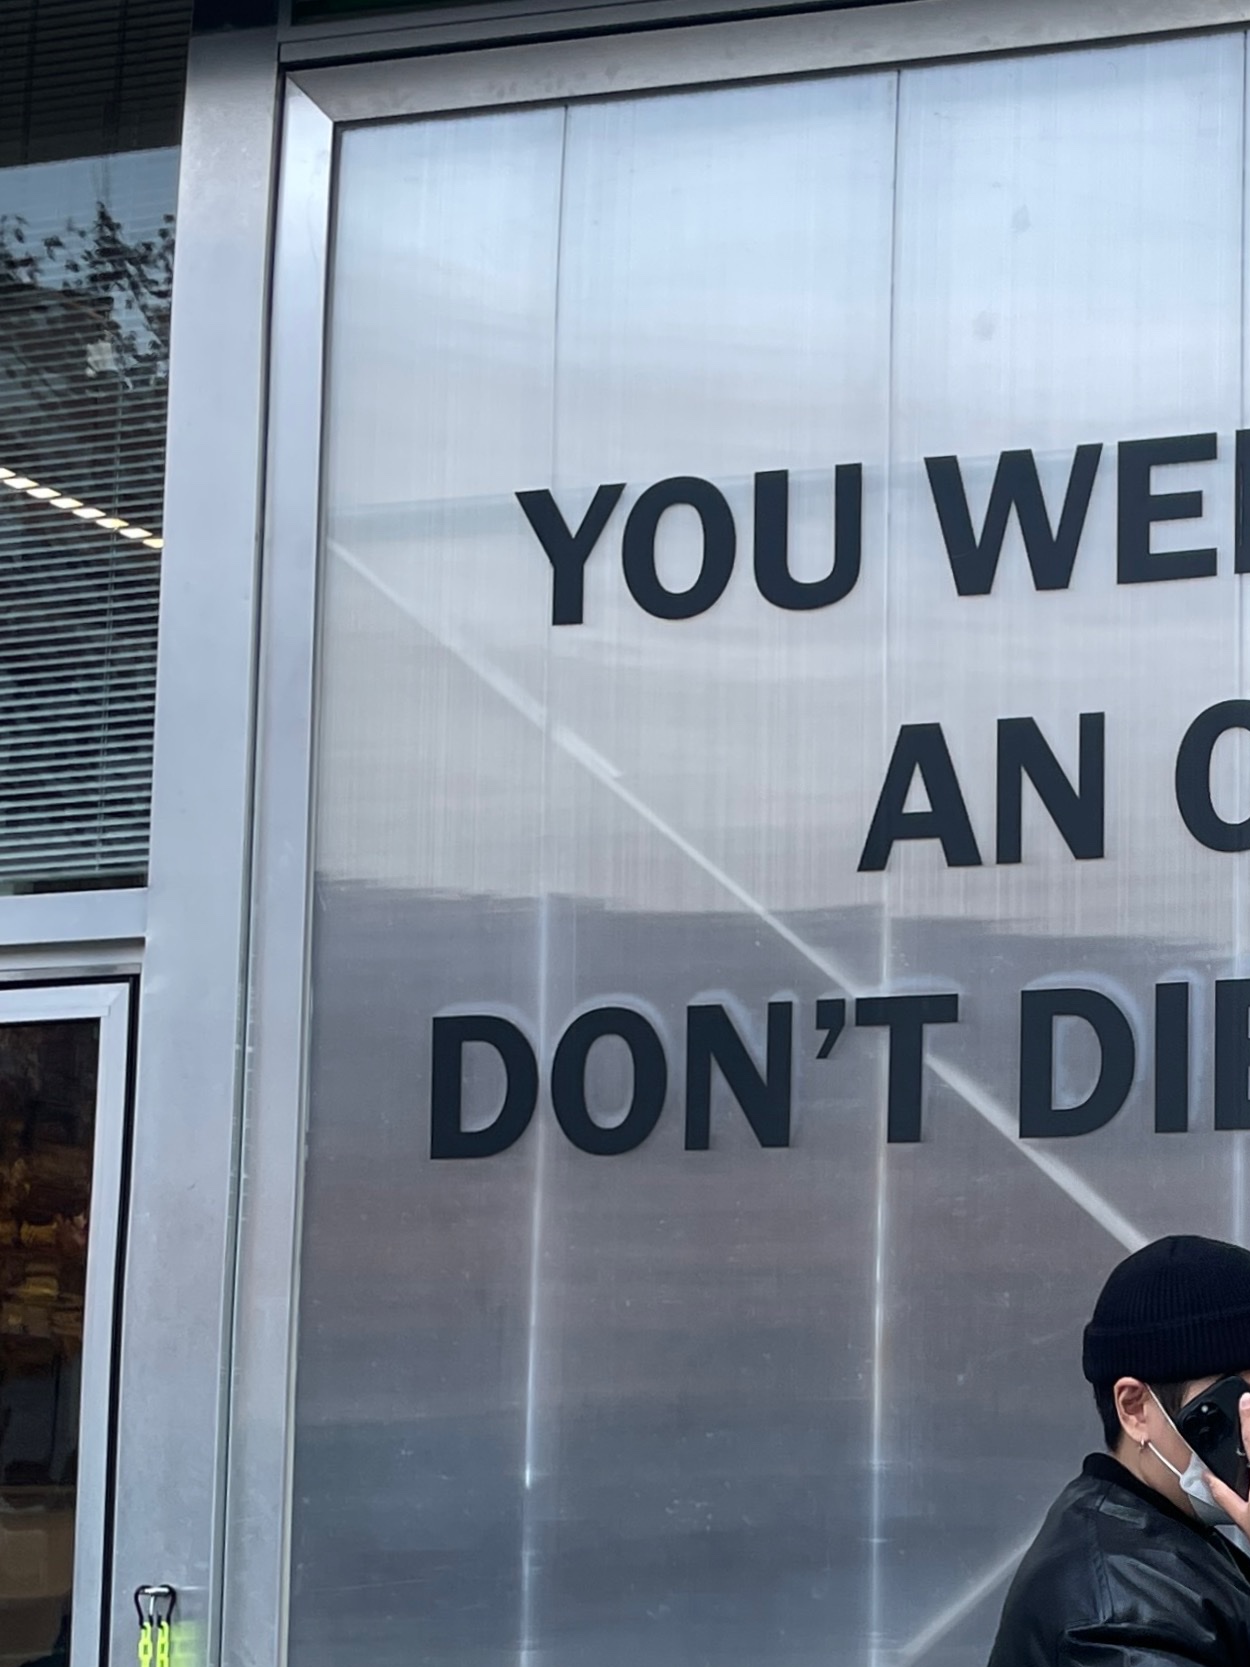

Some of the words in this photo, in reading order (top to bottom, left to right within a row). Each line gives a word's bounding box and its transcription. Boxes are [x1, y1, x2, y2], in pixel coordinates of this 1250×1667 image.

[515, 463, 862, 626] YOU
[857, 712, 1105, 872] AN
[429, 993, 959, 1160] DON’T
